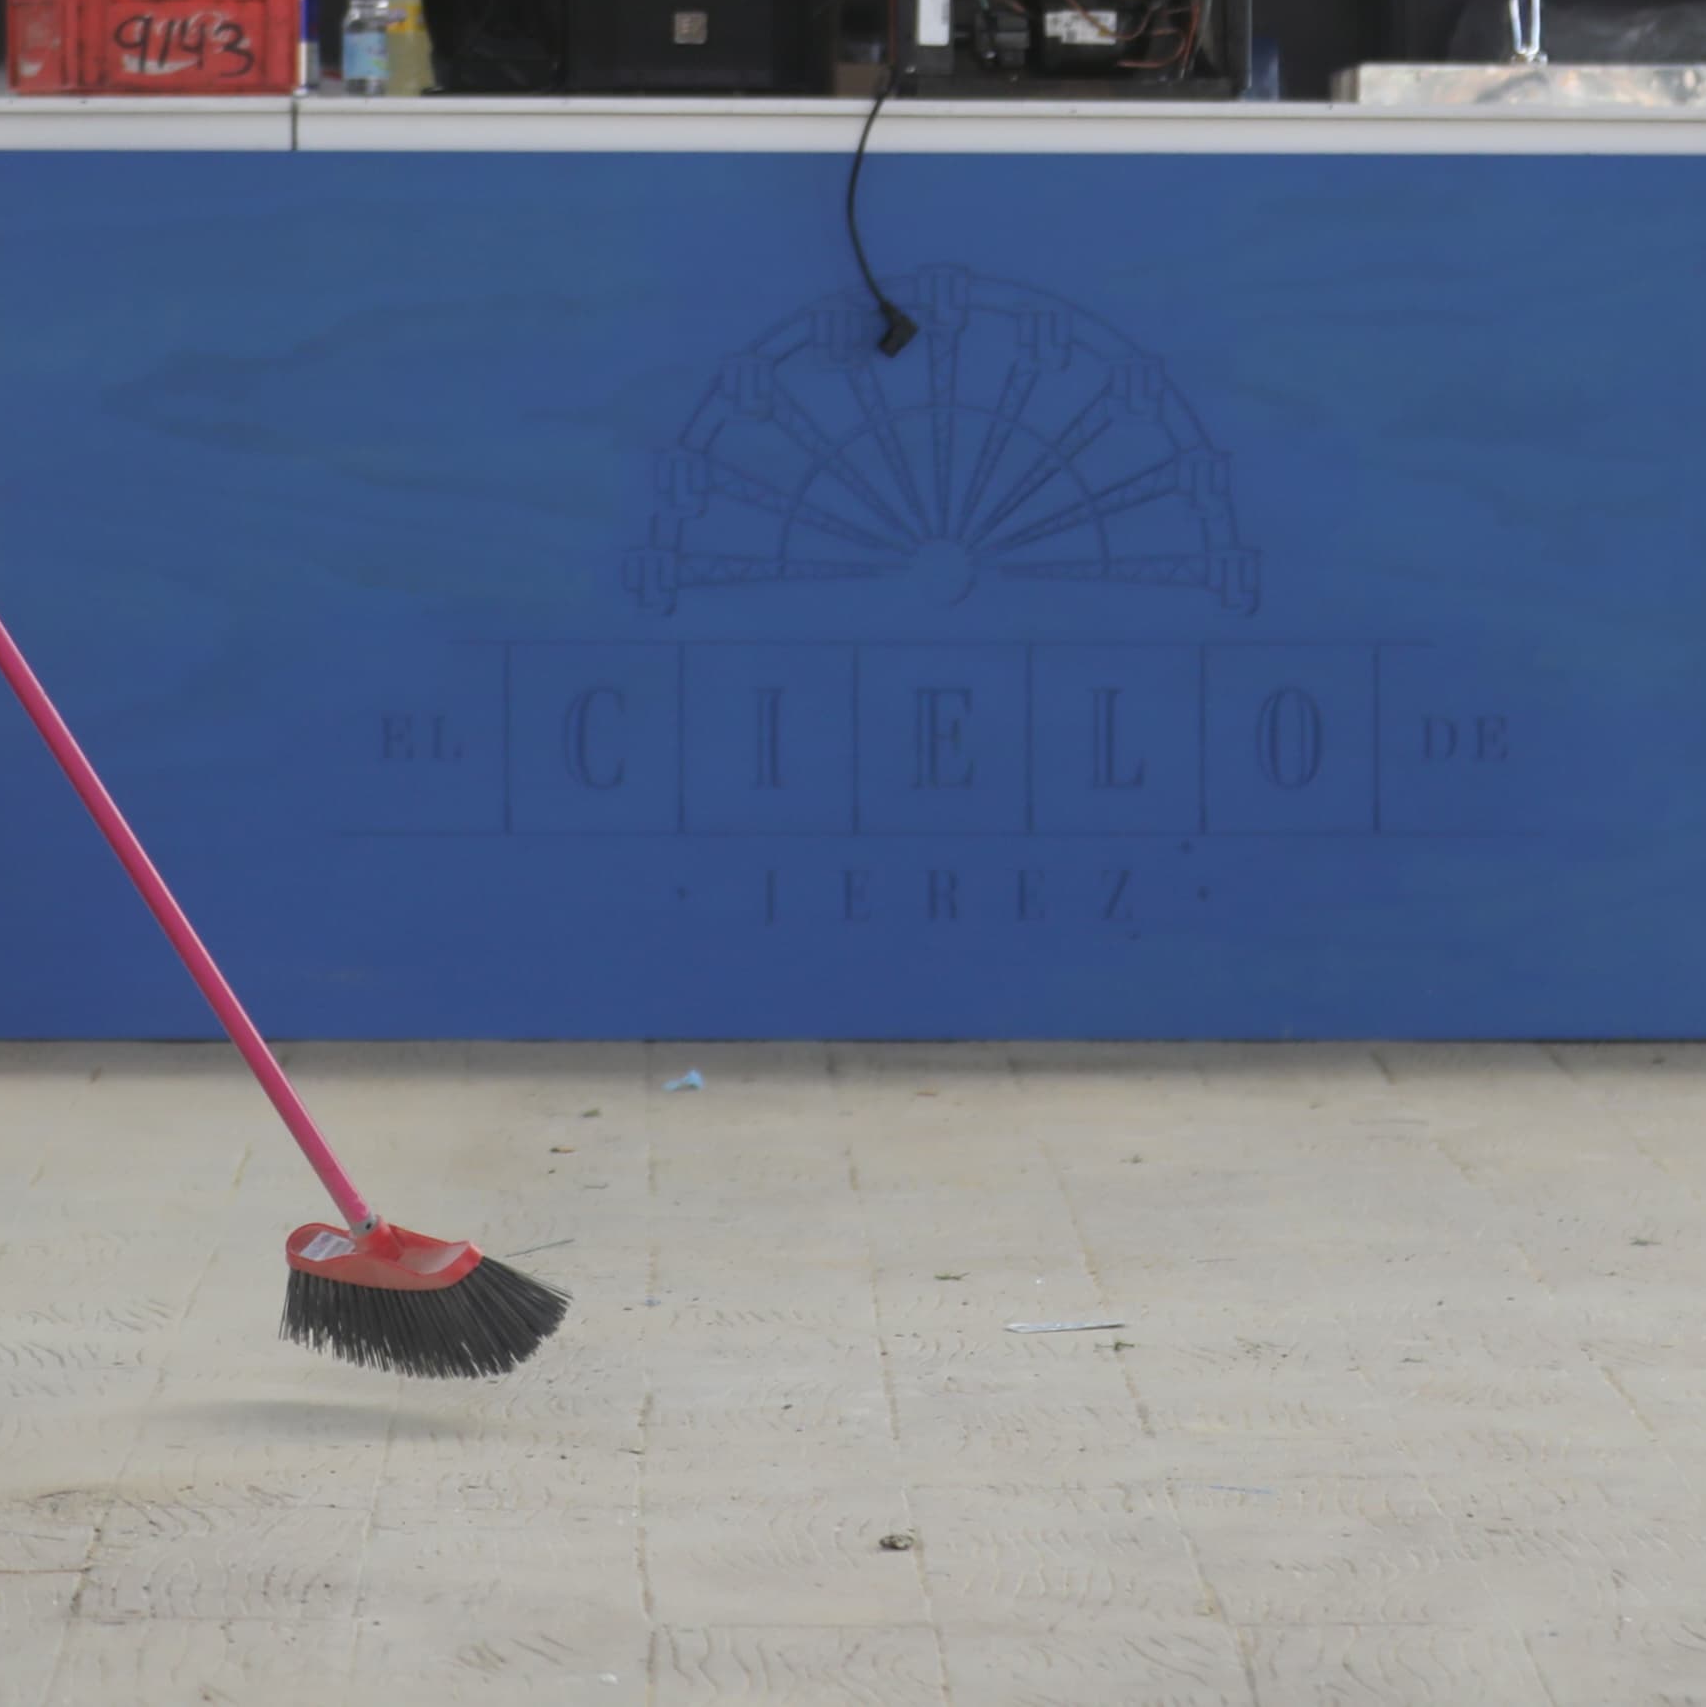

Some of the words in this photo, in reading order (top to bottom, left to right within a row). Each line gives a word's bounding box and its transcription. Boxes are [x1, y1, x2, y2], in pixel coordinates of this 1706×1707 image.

[378, 713, 465, 764] EL
[561, 685, 1325, 791] CIELO
[1419, 714, 1511, 764] DE
